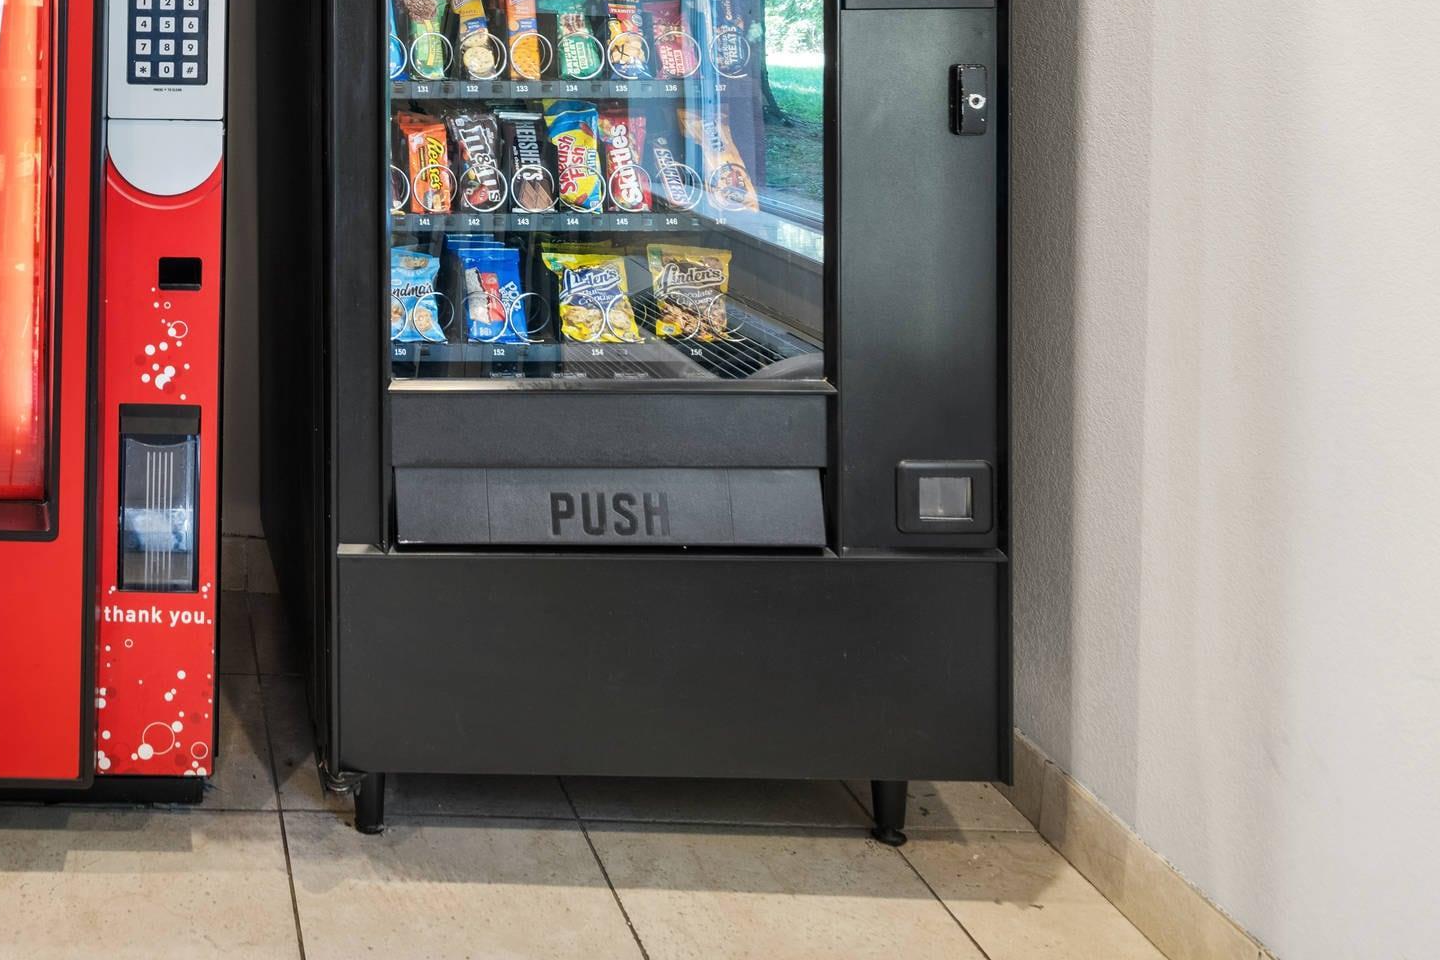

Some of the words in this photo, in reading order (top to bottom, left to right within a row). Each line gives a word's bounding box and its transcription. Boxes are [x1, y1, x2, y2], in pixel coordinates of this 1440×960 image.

[188, 21, 194, 29] 6
[164, 43, 170, 51] 8
[418, 85, 429, 93] 131
[467, 85, 479, 93] 132
[517, 85, 529, 93] 133
[566, 84, 578, 92] 134
[616, 84, 628, 92] 135
[568, 147, 586, 180] Fsh
[420, 218, 431, 226] 141
[469, 218, 480, 226] 142
[518, 217, 530, 226] 143
[567, 217, 579, 226] 144
[617, 217, 629, 226] 145
[666, 217, 678, 225] 146
[655, 263, 724, 298] Linden's
[395, 348, 407, 356] 150
[494, 348, 505, 356] 152
[592, 348, 604, 356] 154
[691, 348, 703, 356] 156
[549, 490, 669, 537] PUSH
[104, 605, 162, 624] thank
[170, 608, 212, 627] you.
